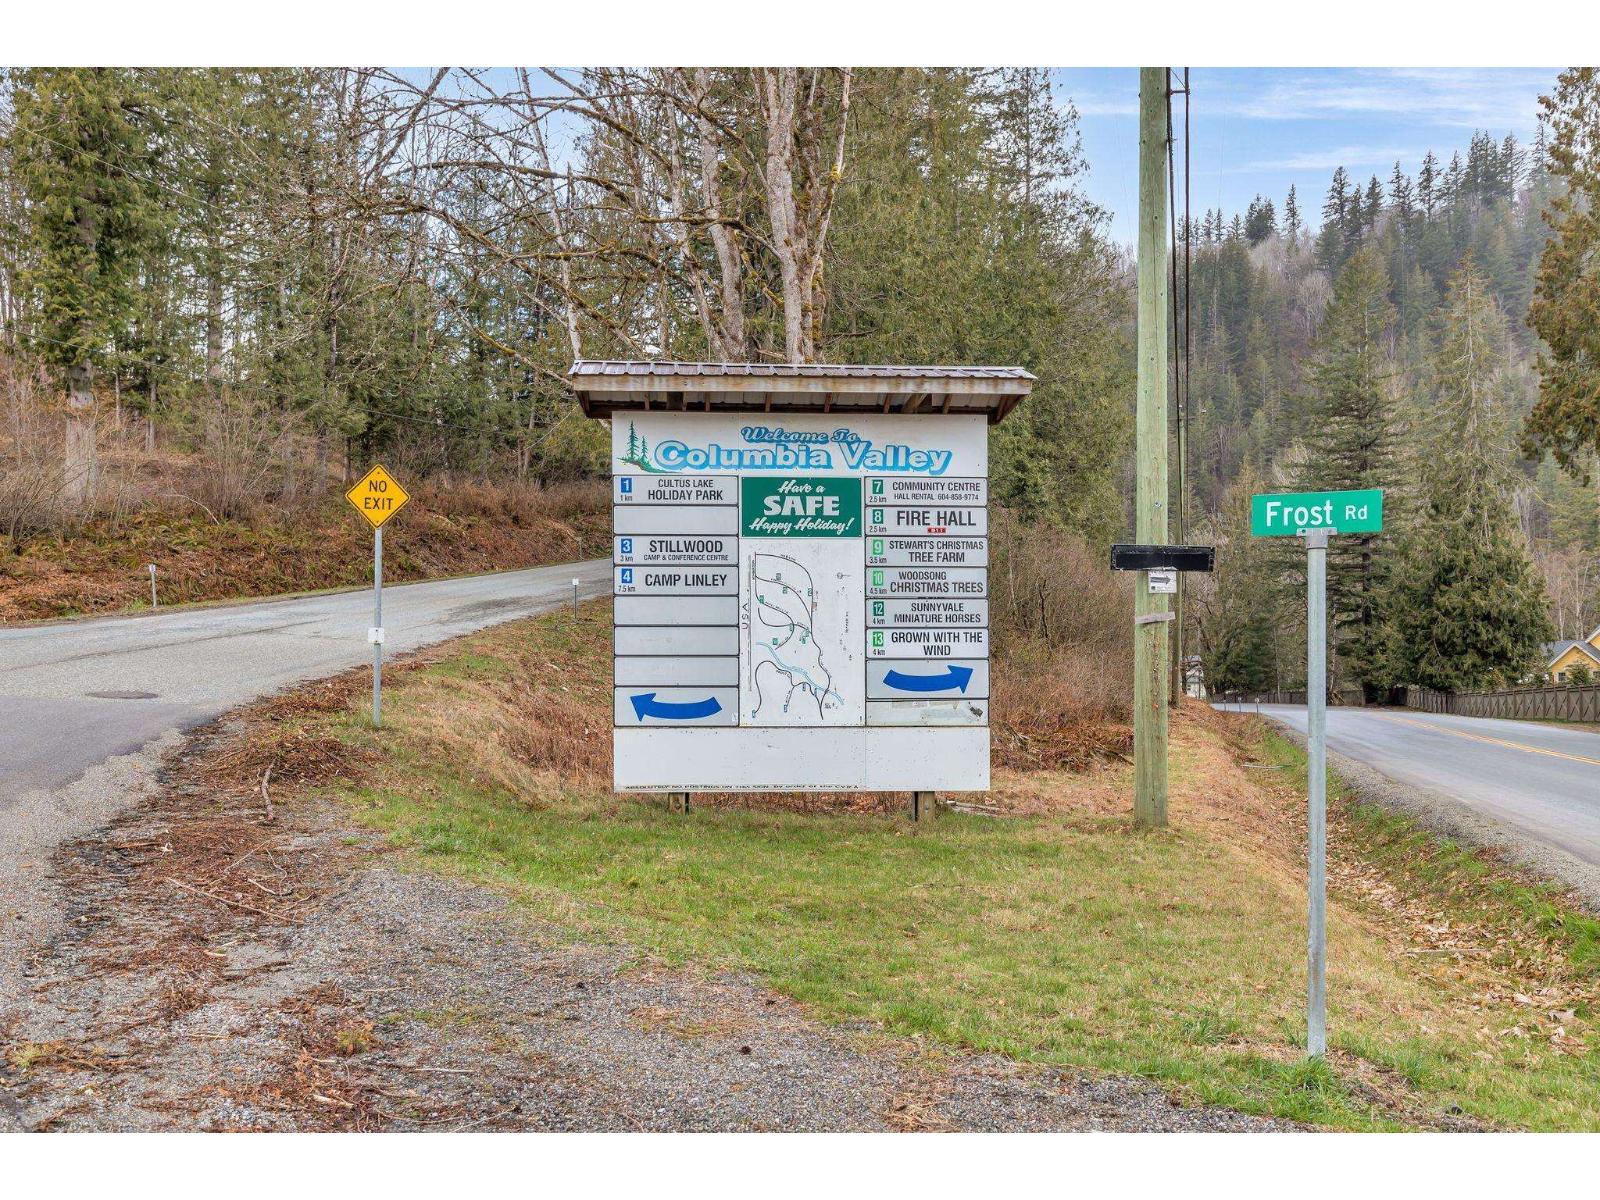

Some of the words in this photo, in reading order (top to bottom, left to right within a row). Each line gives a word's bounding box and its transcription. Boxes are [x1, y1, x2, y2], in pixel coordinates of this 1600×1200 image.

[741, 426, 829, 444] Welcome
[831, 428, 861, 443] To
[654, 439, 833, 471] Columbia
[838, 440, 953, 475] Valley
[368, 480, 387, 492] NO
[622, 479, 631, 491] 1
[658, 479, 690, 488] CULTUS
[693, 479, 713, 488] LAKE
[778, 479, 812, 494] Have
[815, 485, 826, 493] a
[873, 481, 881, 493] 7
[892, 482, 946, 491] COMMUNITY
[947, 482, 981, 492] CENTRE
[648, 490, 693, 500] HOLIDAY
[695, 490, 723, 500] PARK
[364, 497, 394, 510] EXIT
[763, 495, 840, 516] SAFE
[874, 510, 881, 522] 8
[896, 510, 931, 526] FIRE
[936, 510, 976, 526] HALL
[1266, 500, 1333, 526] Frost
[1345, 505, 1368, 520] Rd
[749, 516, 792, 535] Happy
[793, 516, 855, 535] Holiday!
[622, 540, 630, 552] 3
[649, 540, 723, 553] STILLWOOD
[874, 541, 881, 553] 9
[889, 540, 935, 550] STEWART'S
[936, 540, 984, 550] CHRISTMAS
[909, 551, 934, 562] TREE
[936, 552, 965, 562] FARM
[623, 570, 631, 582] 4
[645, 574, 681, 587] CAMP
[684, 574, 728, 587] LINLEY
[874, 572, 882, 584] 10
[898, 571, 947, 580] WOODSONG
[618, 585, 627, 593] 7.5
[627, 585, 636, 593] km
[890, 581, 949, 593] CHRISTMAS
[951, 581, 984, 593] TREES
[874, 602, 883, 613] 12
[911, 602, 964, 612] SUNNYVALE
[741, 602, 749, 630] USA
[894, 614, 943, 624] MINIATURE
[945, 614, 981, 624] HORSES
[873, 633, 882, 644] 13
[891, 632, 930, 643] GROWN
[933, 632, 960, 643] WITH
[963, 632, 983, 643] THE
[877, 648, 886, 656] km
[923, 645, 951, 656] WIND
